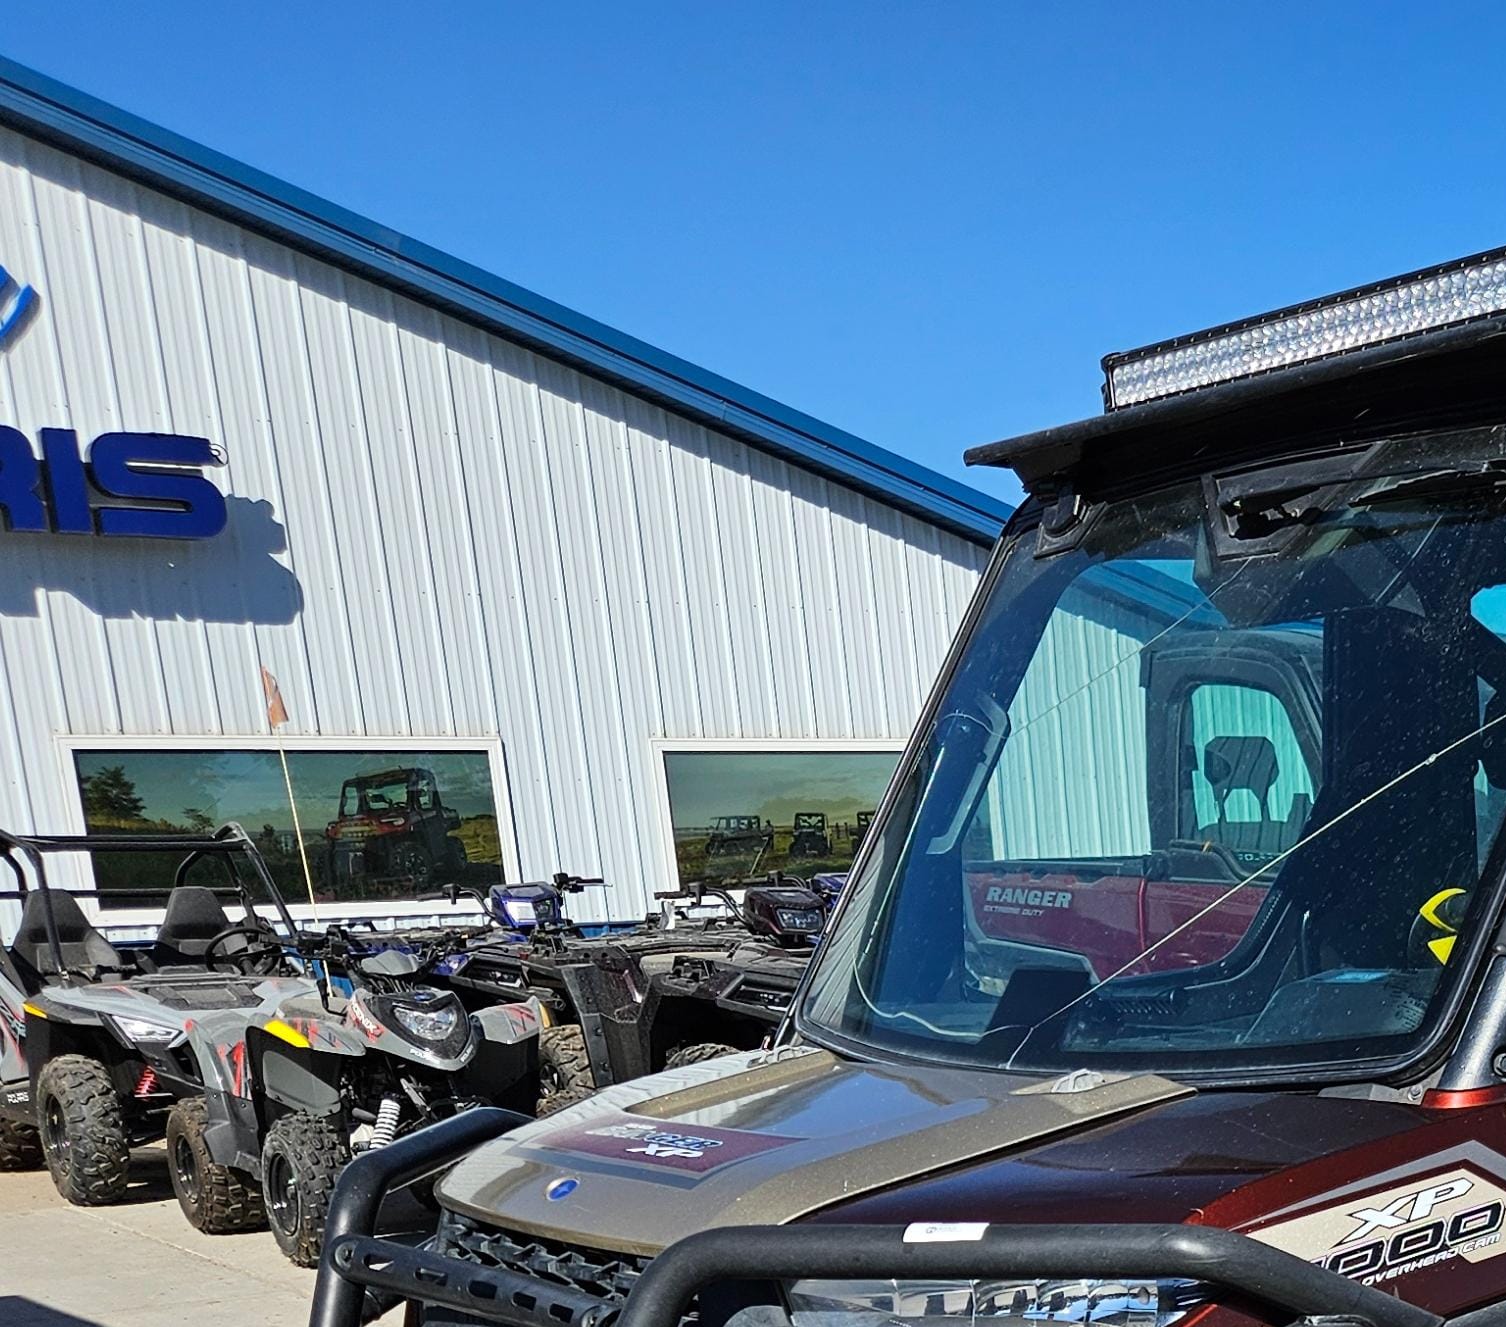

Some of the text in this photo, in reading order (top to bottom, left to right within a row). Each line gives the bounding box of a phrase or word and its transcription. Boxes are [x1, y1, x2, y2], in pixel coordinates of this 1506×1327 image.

[985, 886, 1073, 909] RANGER
[1021, 908, 1045, 917] DUTY
[625, 1143, 704, 1158] XP
[1328, 1177, 1476, 1250] XP
[1361, 1232, 1501, 1287] OVERHEAD CAM
